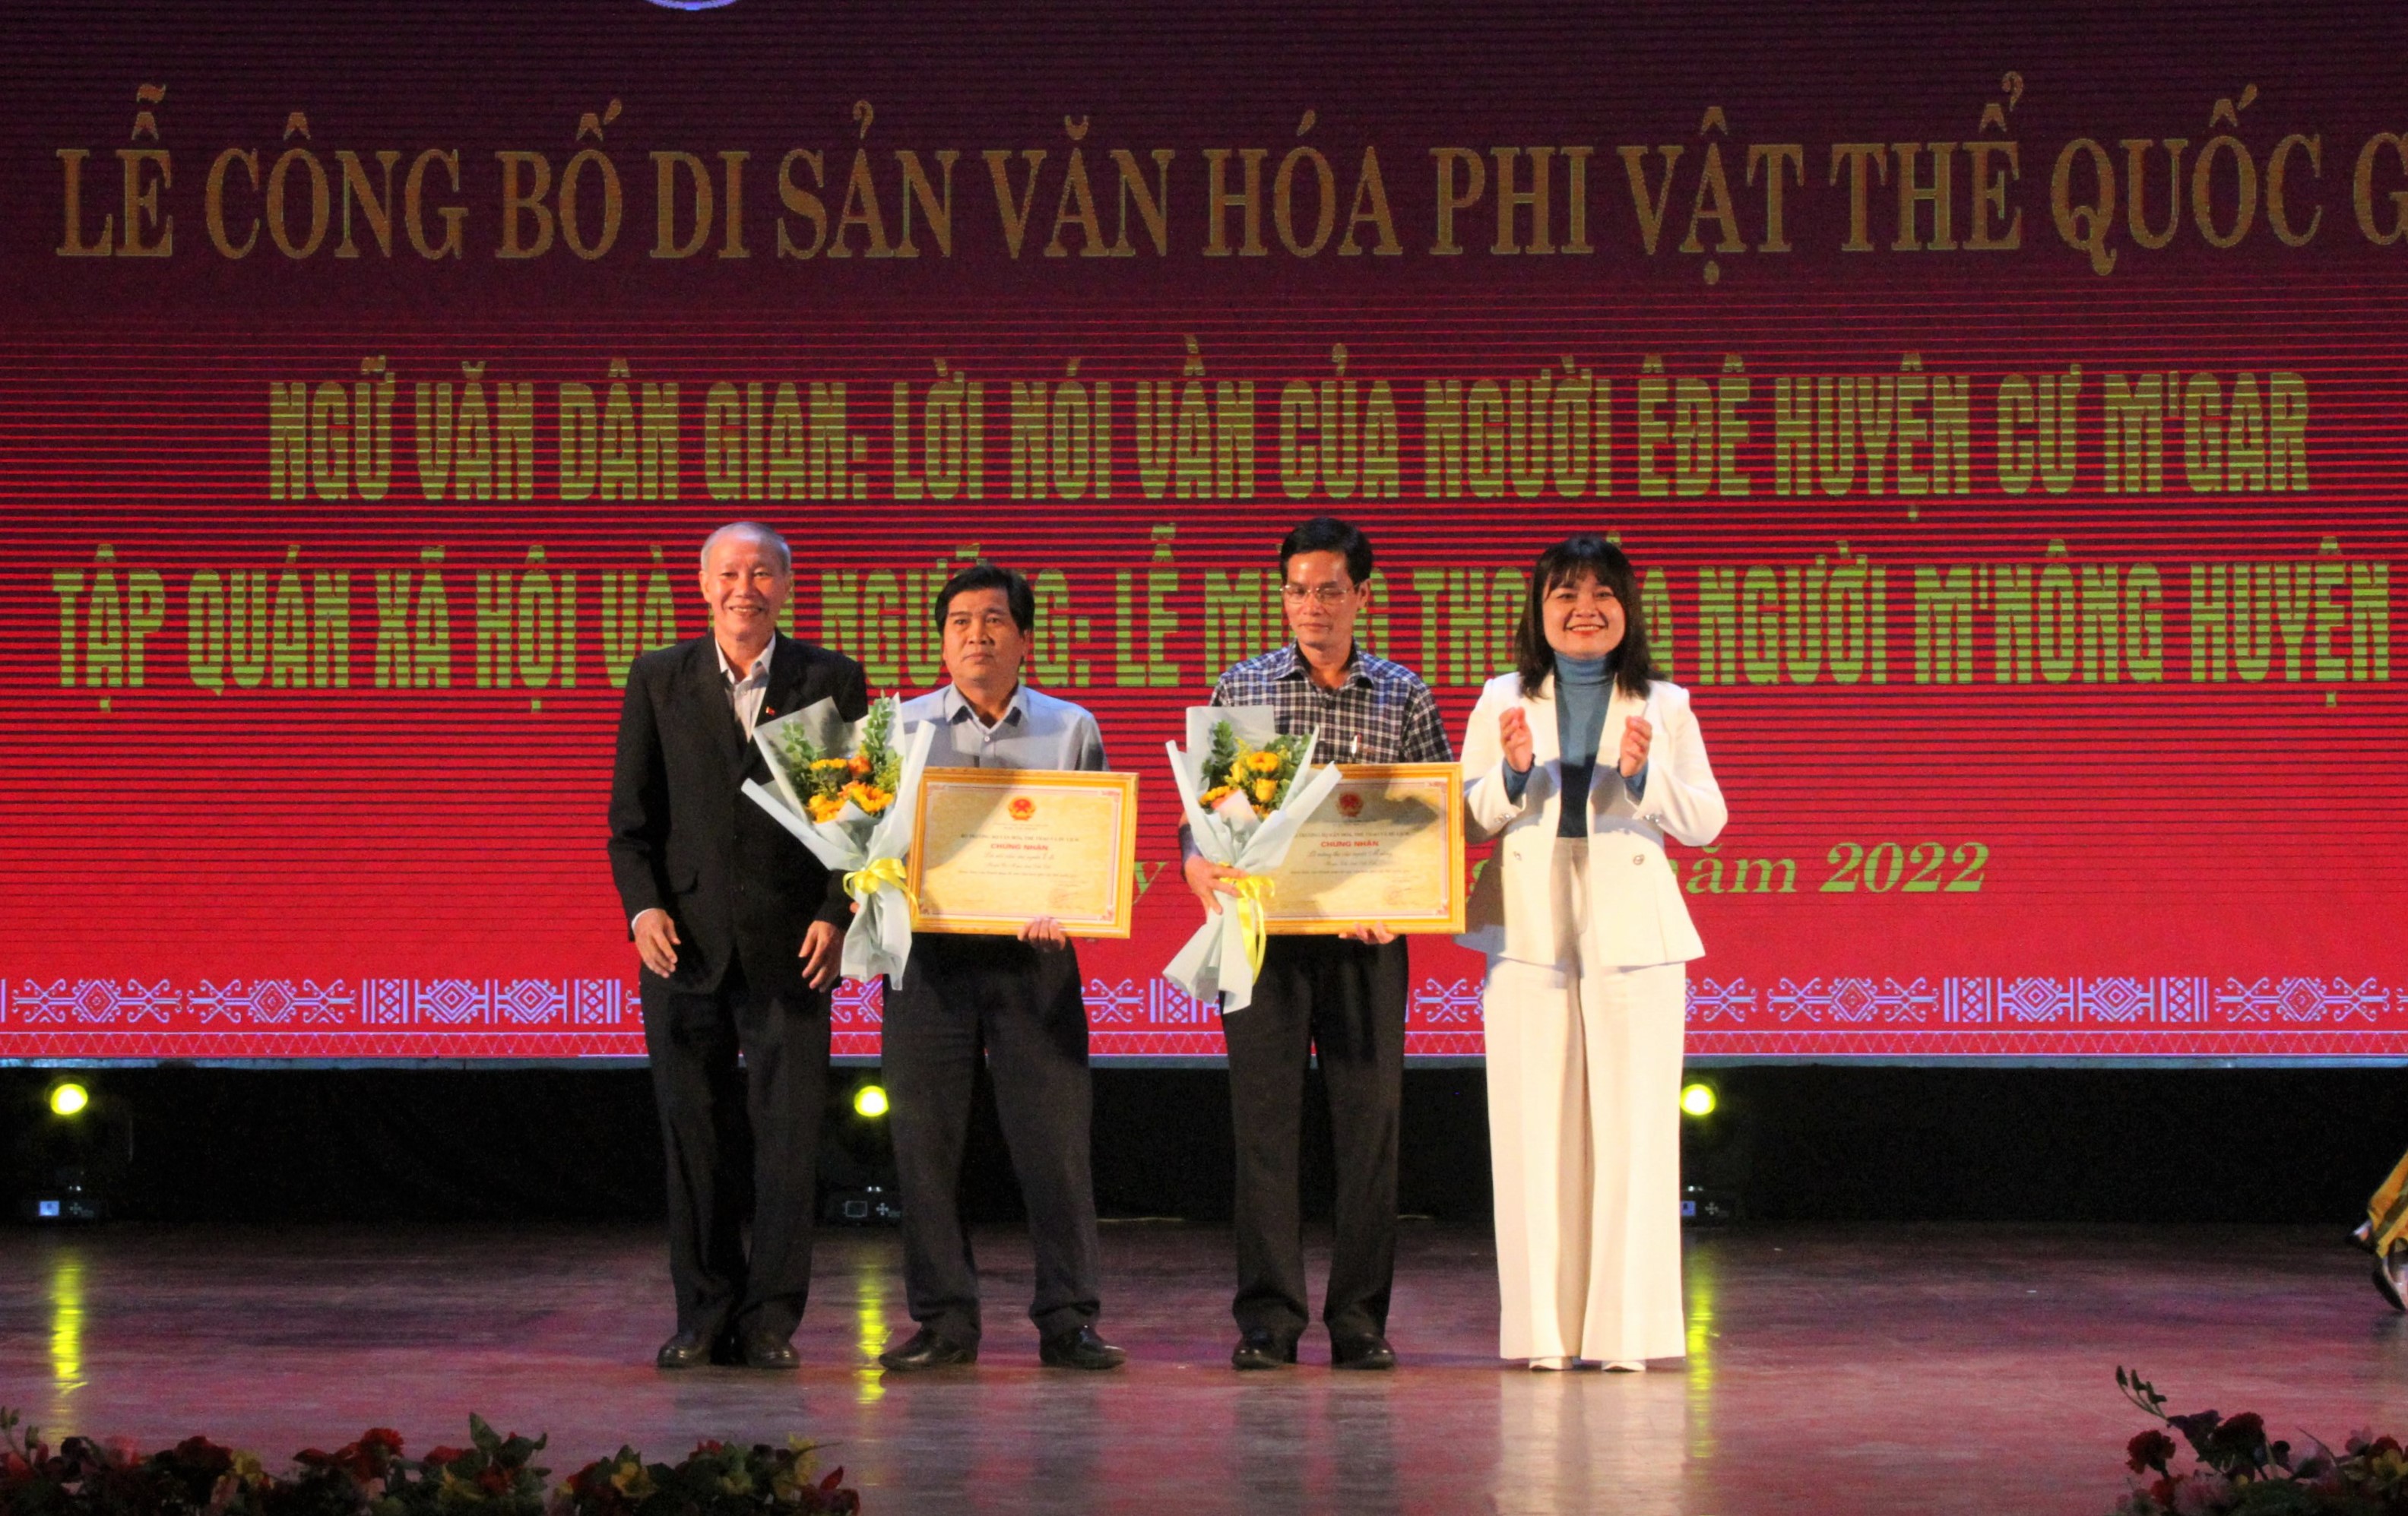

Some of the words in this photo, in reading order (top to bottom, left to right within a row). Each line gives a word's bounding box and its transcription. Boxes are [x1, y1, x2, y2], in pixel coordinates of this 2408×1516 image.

[56, 83, 173, 258] LỄ
[204, 112, 469, 260] CÔNG
[494, 98, 623, 260] BỐ
[649, 150, 751, 259] DI
[777, 100, 960, 260] SẢN
[982, 114, 1175, 260] VĂN
[1202, 109, 1403, 258] HÓA
[1429, 146, 1594, 255] PHI
[1617, 105, 1804, 285] VẬT
[1829, 71, 2022, 252] THỂ
[2050, 83, 2322, 277] QUỐC
[269, 354, 396, 500] NGỮ
[414, 361, 534, 500] VĂN
[559, 358, 680, 500] DÂN
[704, 381, 868, 500] GIAN:
[893, 357, 984, 499] LỜI
[1010, 356, 1111, 499] NÓI
[1136, 334, 1255, 499] VẦN
[1279, 343, 1401, 498] CỦA
[1424, 354, 1611, 498] NGƯỜI
[1775, 351, 1970, 522] HUYỆN
[1997, 362, 2082, 494] CƯ
[52, 543, 166, 713] TẬP
[188, 544, 350, 697] QUÁN
[374, 544, 452, 688] XÃ
[476, 545, 577, 711] HỘI
[1115, 522, 1180, 688] LỄ
[1698, 540, 1887, 685] NGƯỜI
[2190, 536, 2391, 708] HUYỆN
[1818, 841, 1991, 894] 2022
